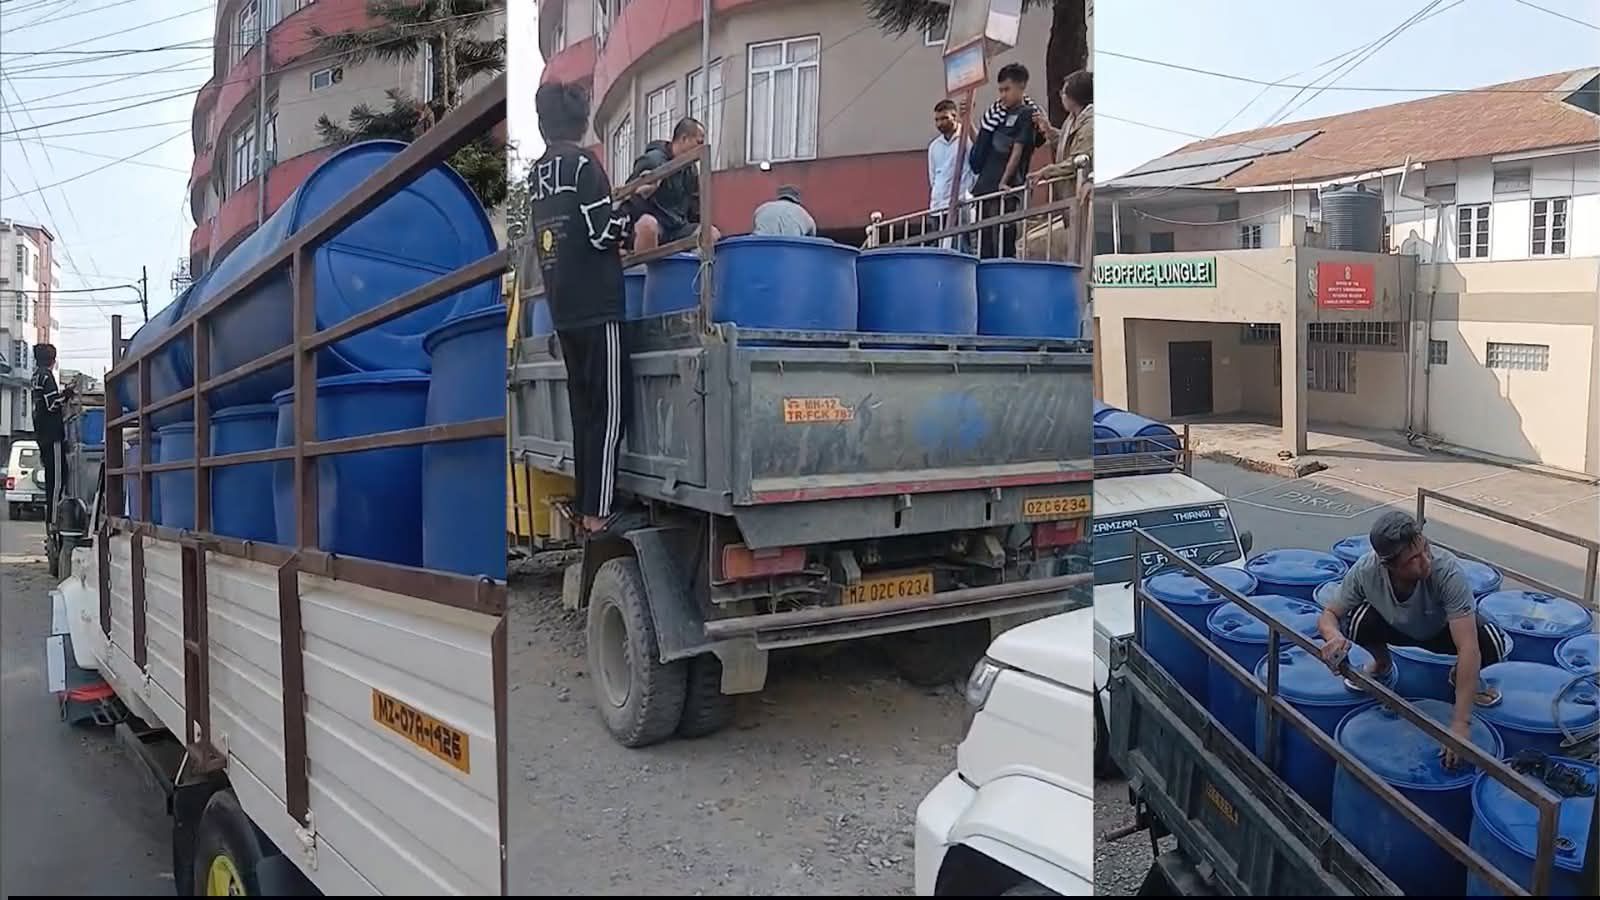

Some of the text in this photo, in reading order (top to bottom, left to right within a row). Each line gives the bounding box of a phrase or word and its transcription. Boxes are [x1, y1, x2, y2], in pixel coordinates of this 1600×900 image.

[1157, 262, 1212, 284] LUNGLEI
[1173, 509, 1211, 521] THIANGI
[1093, 519, 1139, 533] ZAMZAM
[870, 582, 896, 601] 02C
[898, 579, 930, 597] 6234
